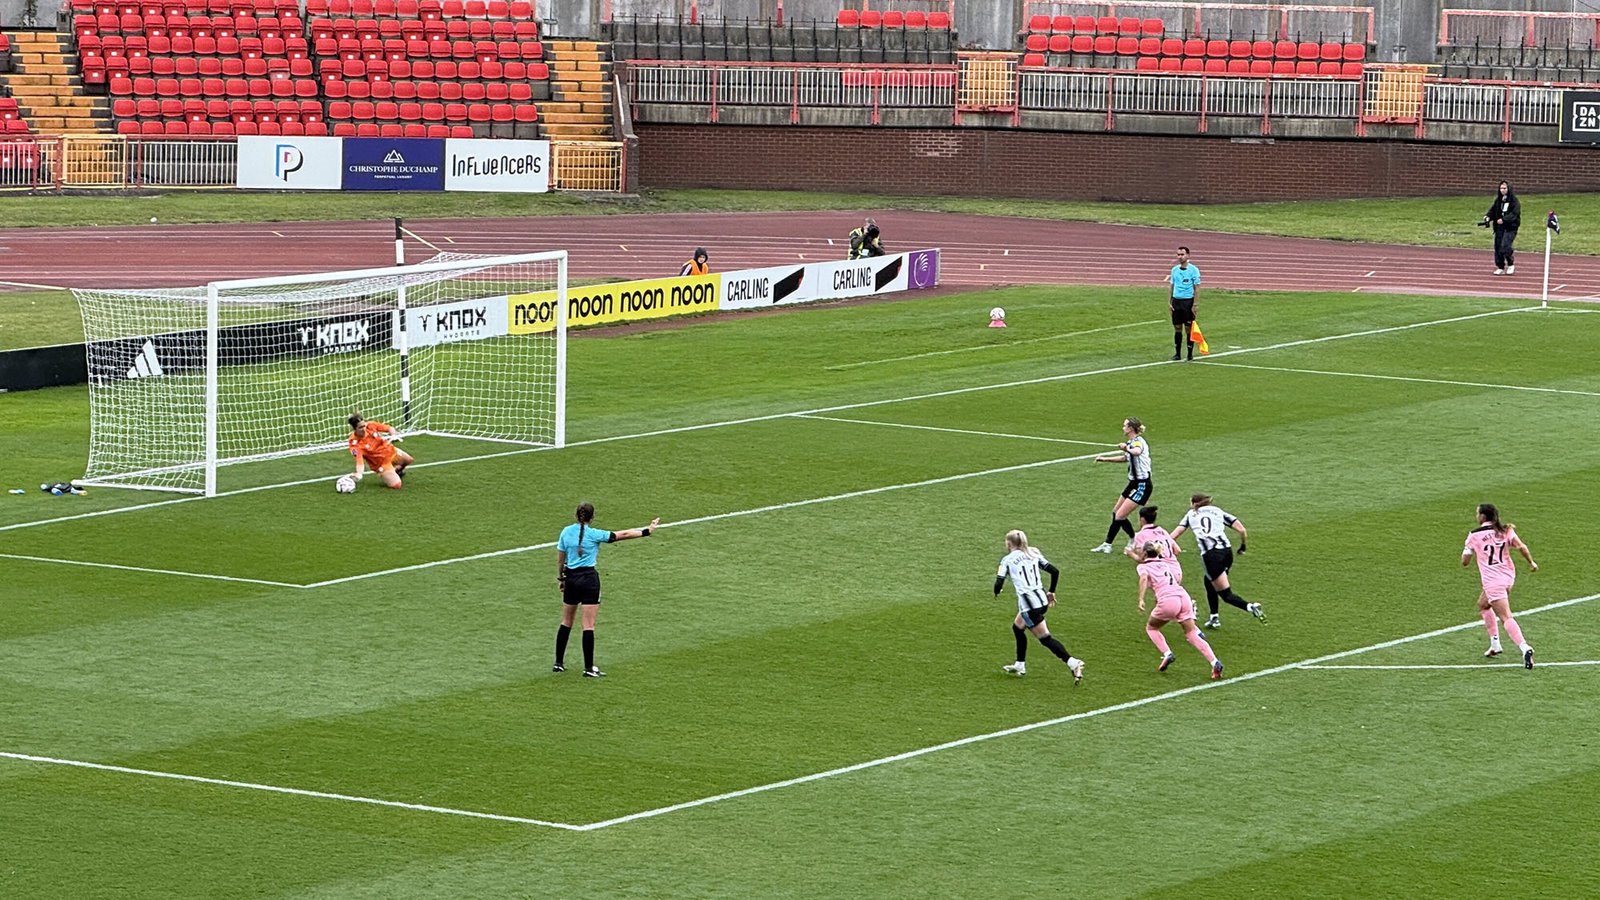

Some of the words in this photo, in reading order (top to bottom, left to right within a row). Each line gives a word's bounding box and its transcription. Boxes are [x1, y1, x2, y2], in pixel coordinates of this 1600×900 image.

[1579, 106, 1597, 117] DA
[1579, 117, 1597, 128] ZN
[349, 165, 398, 173] CHRISTOPHE
[399, 166, 439, 174] DUCHAMP
[833, 266, 872, 291] CARLING
[727, 277, 770, 302] CARLING
[568, 293, 613, 319] noon
[620, 288, 665, 313] noon
[670, 282, 715, 307] noon
[1199, 516, 1212, 534] 9
[1483, 541, 1506, 566] 27
